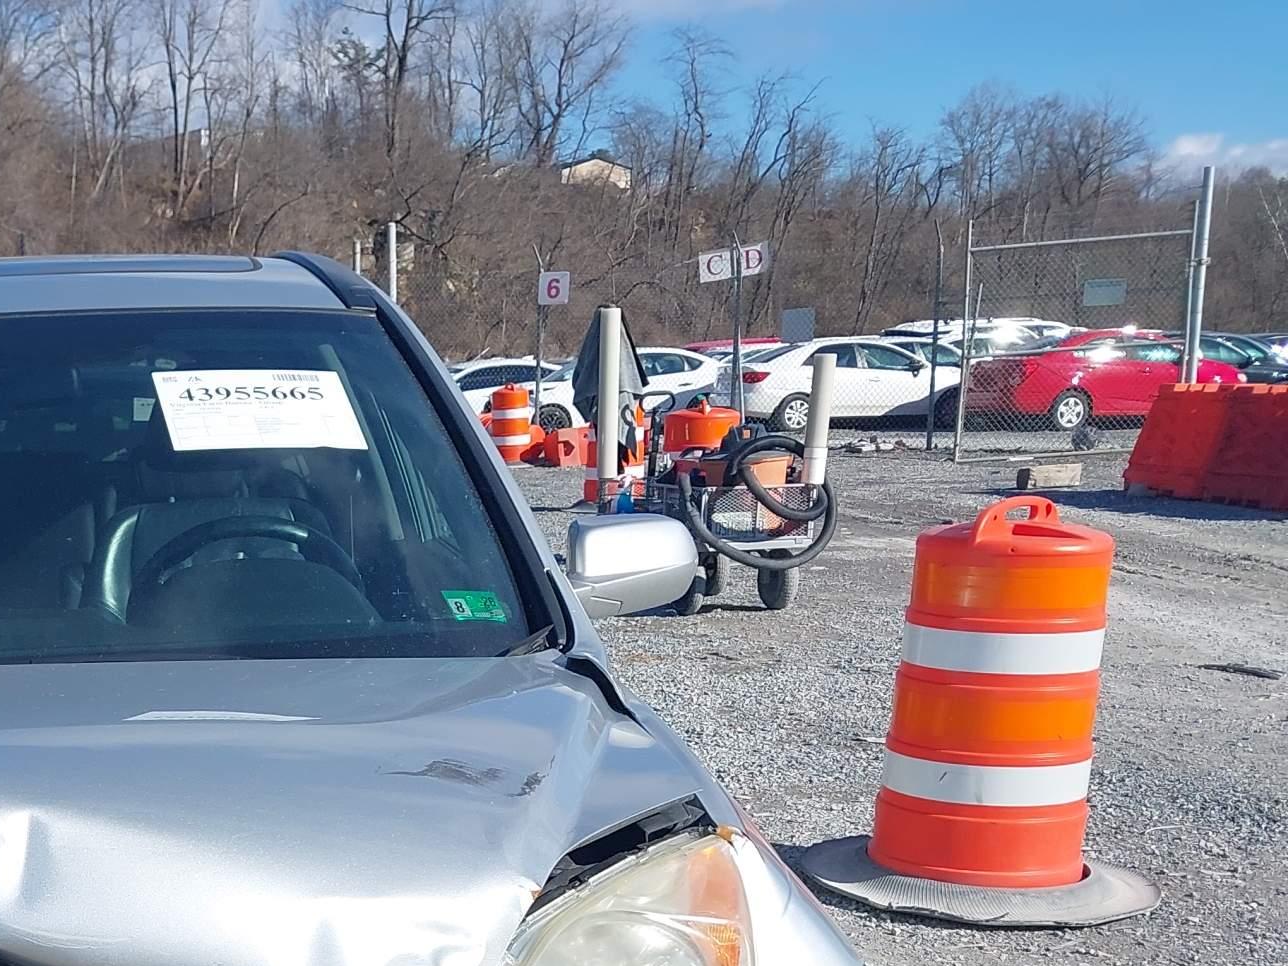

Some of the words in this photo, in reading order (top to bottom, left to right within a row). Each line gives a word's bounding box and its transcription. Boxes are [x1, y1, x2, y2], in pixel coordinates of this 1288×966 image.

[706, 254, 724, 275] C
[744, 248, 763, 270] D
[546, 278, 561, 299] 6
[178, 386, 325, 402] 43955665
[454, 601, 466, 613] 8
